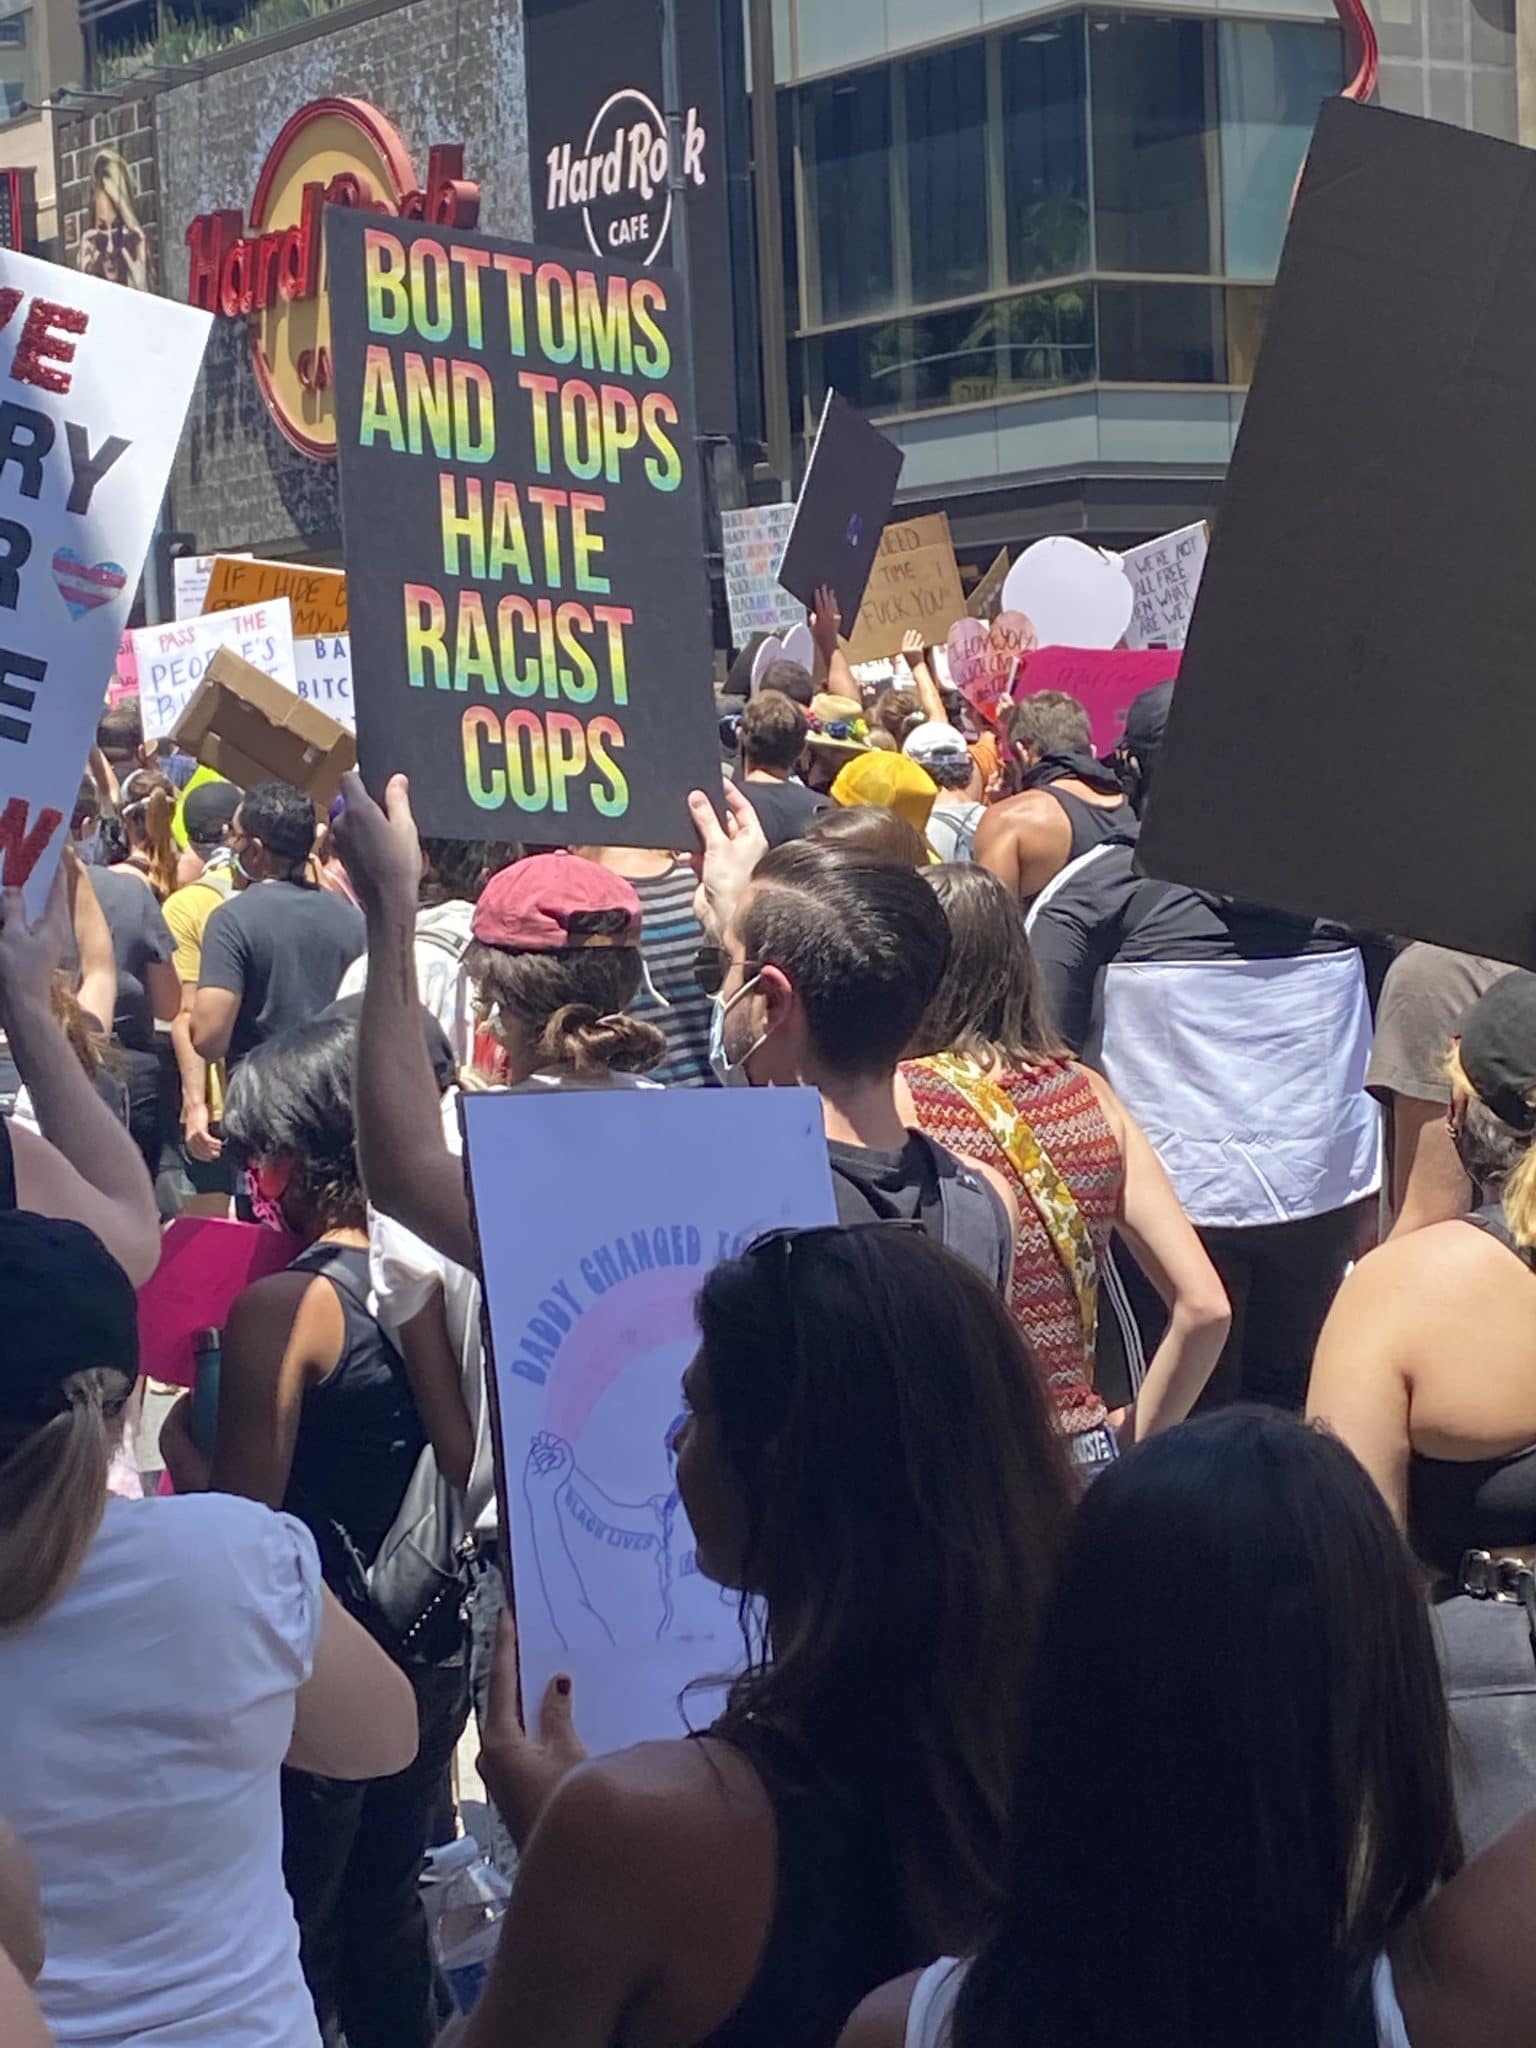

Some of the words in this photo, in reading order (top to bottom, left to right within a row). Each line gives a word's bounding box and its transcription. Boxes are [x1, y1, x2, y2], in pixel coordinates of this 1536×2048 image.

[546, 127, 624, 210] Hard
[627, 107, 706, 200] Rok
[185, 180, 322, 318] Hard
[608, 213, 649, 246] CAFE
[361, 228, 671, 379] BOTTOMS
[359, 344, 496, 463] AND
[518, 371, 682, 492] TOPS
[223, 565, 247, 592] IF
[273, 570, 325, 604] HIDE
[439, 472, 611, 595] HATE
[159, 627, 196, 653] PASS
[231, 610, 267, 635] THE
[402, 582, 634, 705] RACIST
[862, 597, 910, 632] FUCK
[911, 587, 945, 619] YOU
[152, 636, 276, 693] PEOE'S
[461, 705, 630, 818] COPS
[511, 1279, 582, 1386] DADDY
